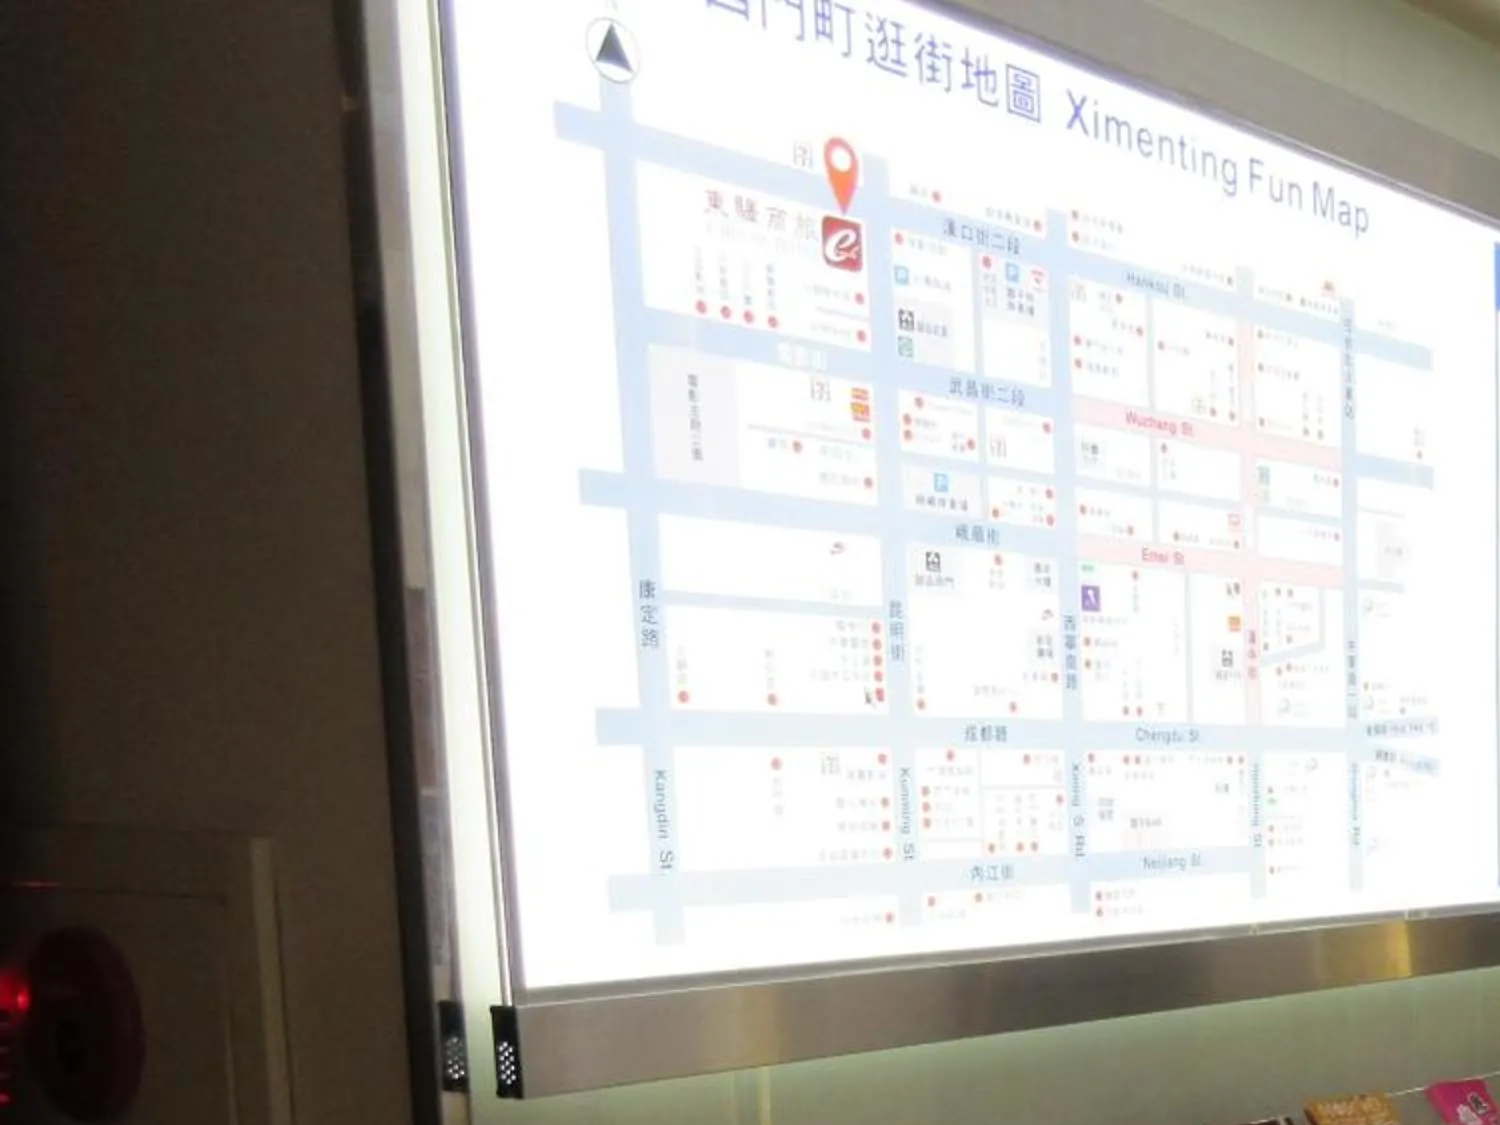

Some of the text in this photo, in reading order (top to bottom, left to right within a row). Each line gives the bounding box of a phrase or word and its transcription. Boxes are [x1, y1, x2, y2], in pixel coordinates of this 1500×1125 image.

[704, 0, 1370, 239] 門町逛街地圖 Ximenting Fun Map
